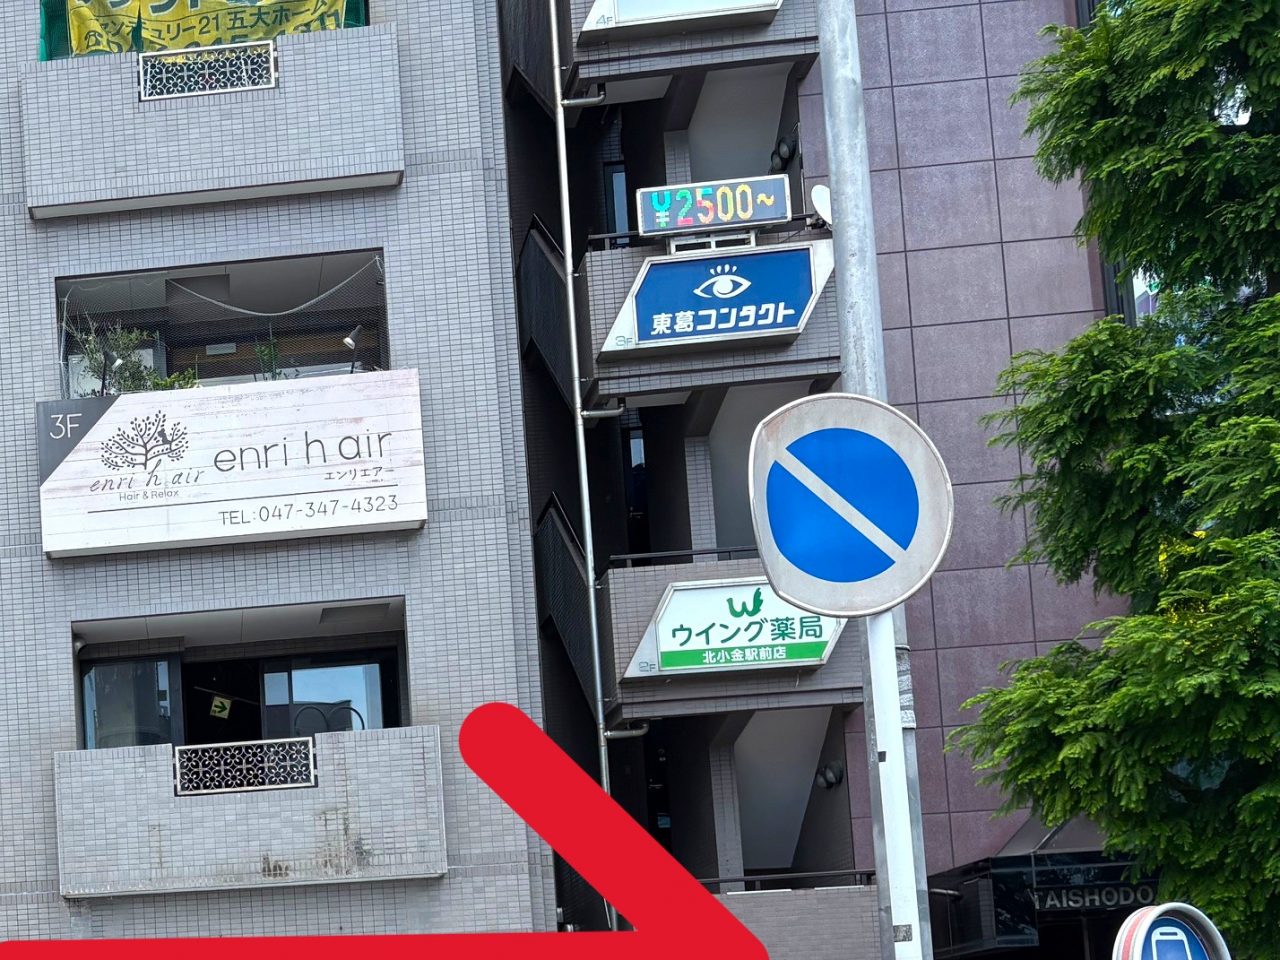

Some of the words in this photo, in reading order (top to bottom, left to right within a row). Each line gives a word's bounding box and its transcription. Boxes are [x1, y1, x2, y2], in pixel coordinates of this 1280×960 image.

[595, 14, 613, 25] 4F
[650, 302, 796, 336] 東葛コンタクト
[615, 335, 633, 347] 3F
[49, 413, 82, 440] 3F
[213, 437, 288, 473] enri
[89, 472, 135, 492] enri
[324, 464, 395, 482] エンリエアー
[119, 490, 140, 501] Hair
[142, 489, 149, 500] &
[151, 488, 179, 498] Relax
[671, 615, 824, 647] ウイング薬局
[702, 646, 787, 665] 北小金駅前店
[638, 661, 657, 673] 2F
[1034, 885, 1155, 910] TAISHODO
